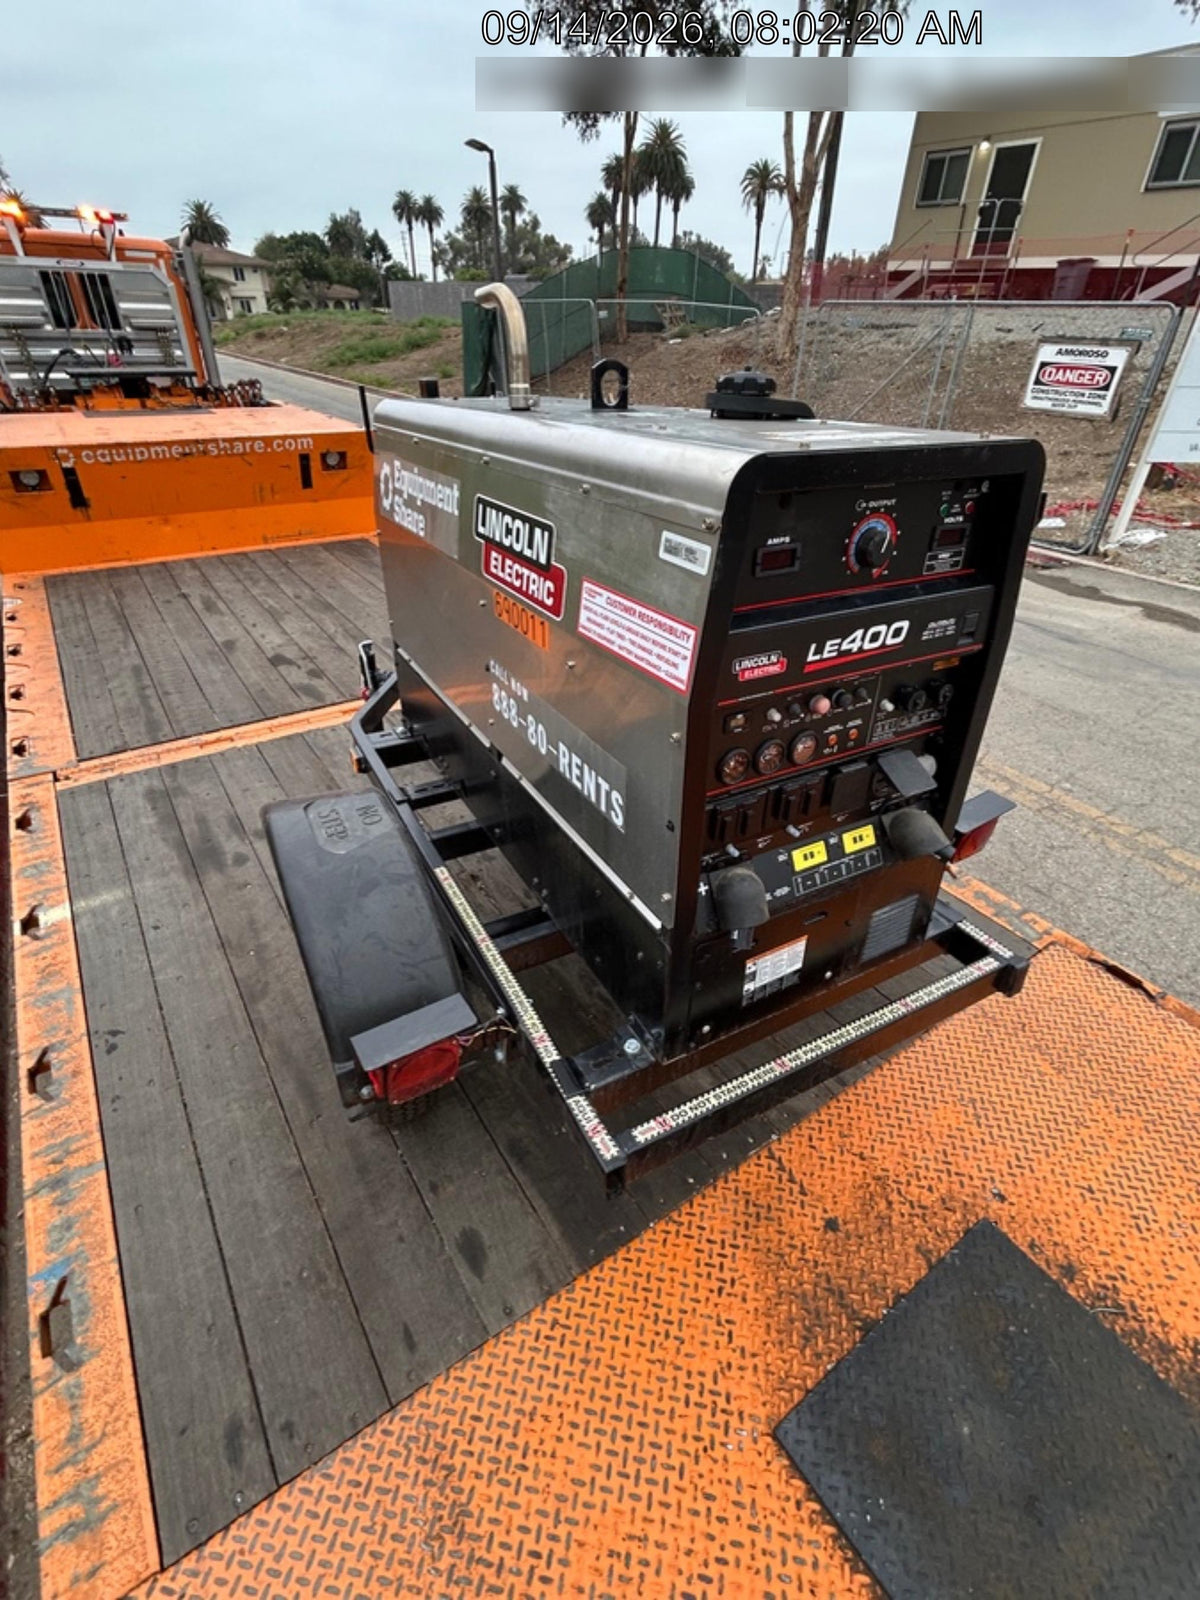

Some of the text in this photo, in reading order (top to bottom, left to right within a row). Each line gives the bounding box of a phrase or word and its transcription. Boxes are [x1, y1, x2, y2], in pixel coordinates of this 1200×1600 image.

[1055, 347, 1109, 359] AMOROSO
[1031, 387, 1108, 400] CONSTRUCTION ZONE
[1043, 367, 1106, 385] DANGER
[394, 459, 459, 516] Equipment
[869, 499, 897, 507] OUTPUT
[393, 495, 426, 537] Share
[477, 503, 549, 565] LINCOLN
[767, 536, 790, 545] AMPS
[489, 550, 555, 606] ELECTRIC
[605, 596, 637, 617] CUSTOMER
[637, 611, 692, 643] RESPONSIBILITY
[807, 620, 910, 662] LE400
[735, 653, 779, 671] LINCOLN
[744, 664, 782, 680] ELECTRIC
[490, 660, 529, 703] CALL NOW
[492, 682, 624, 827] 888-80-RENTS
[317, 808, 349, 840] STEP
[356, 803, 383, 826] NO
[787, 1049, 803, 1063] NE
[802, 1040, 822, 1056] PAS
[821, 1027, 852, 1047] TENEZ
[850, 1009, 888, 1033] DEBOUT
[573, 1096, 593, 1124] AQUI
[670, 1064, 774, 1121] DO NOT STAND HERE
